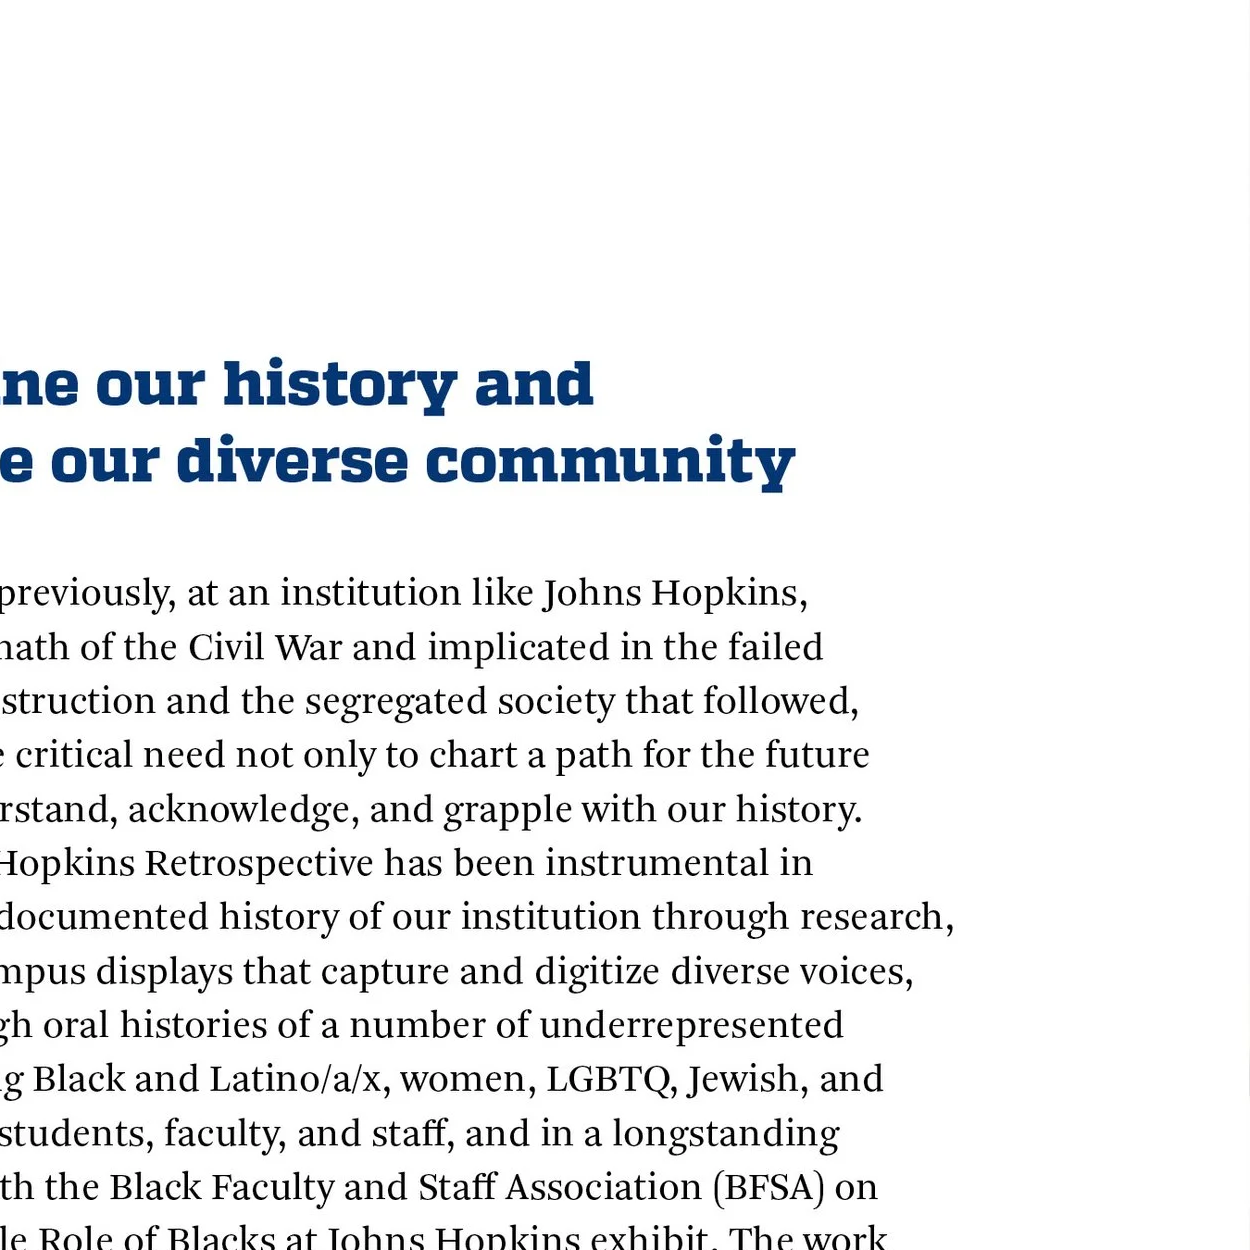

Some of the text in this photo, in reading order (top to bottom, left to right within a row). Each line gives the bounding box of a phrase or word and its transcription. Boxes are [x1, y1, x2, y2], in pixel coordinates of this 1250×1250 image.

[96, 369, 206, 407] our
[223, 355, 459, 417] history
[475, 360, 595, 407] and
[51, 446, 161, 484] our
[177, 432, 409, 484] diverse
[426, 432, 797, 494] community
[188, 579, 219, 607] at
[228, 585, 271, 607] an
[280, 576, 462, 607] institution
[472, 575, 534, 607] like
[541, 576, 642, 613] Johns
[651, 575, 808, 615] Hopkins,
[144, 846, 373, 886] Retrospective
[383, 847, 443, 877] has
[453, 847, 535, 877] been
[545, 846, 770, 877] instrumental
[779, 846, 814, 876] in
[32, 1061, 127, 1093] Black
[135, 1062, 200, 1093] and
[209, 1062, 391, 1100] Latino/a/x,
[399, 1071, 536, 1100] women,
[546, 1064, 678, 1100] LGBTQ,
[685, 1062, 808, 1100] Jewish,
[820, 1062, 884, 1093] and
[44, 1171, 99, 1201] the
[109, 1170, 203, 1201] Black
[211, 1171, 336, 1210] Faculty
[344, 1171, 409, 1201] and
[419, 1170, 500, 1201] Staff
[504, 1170, 703, 1201] Association
[713, 1169, 824, 1211] (BFSA)
[835, 1179, 879, 1201] on
